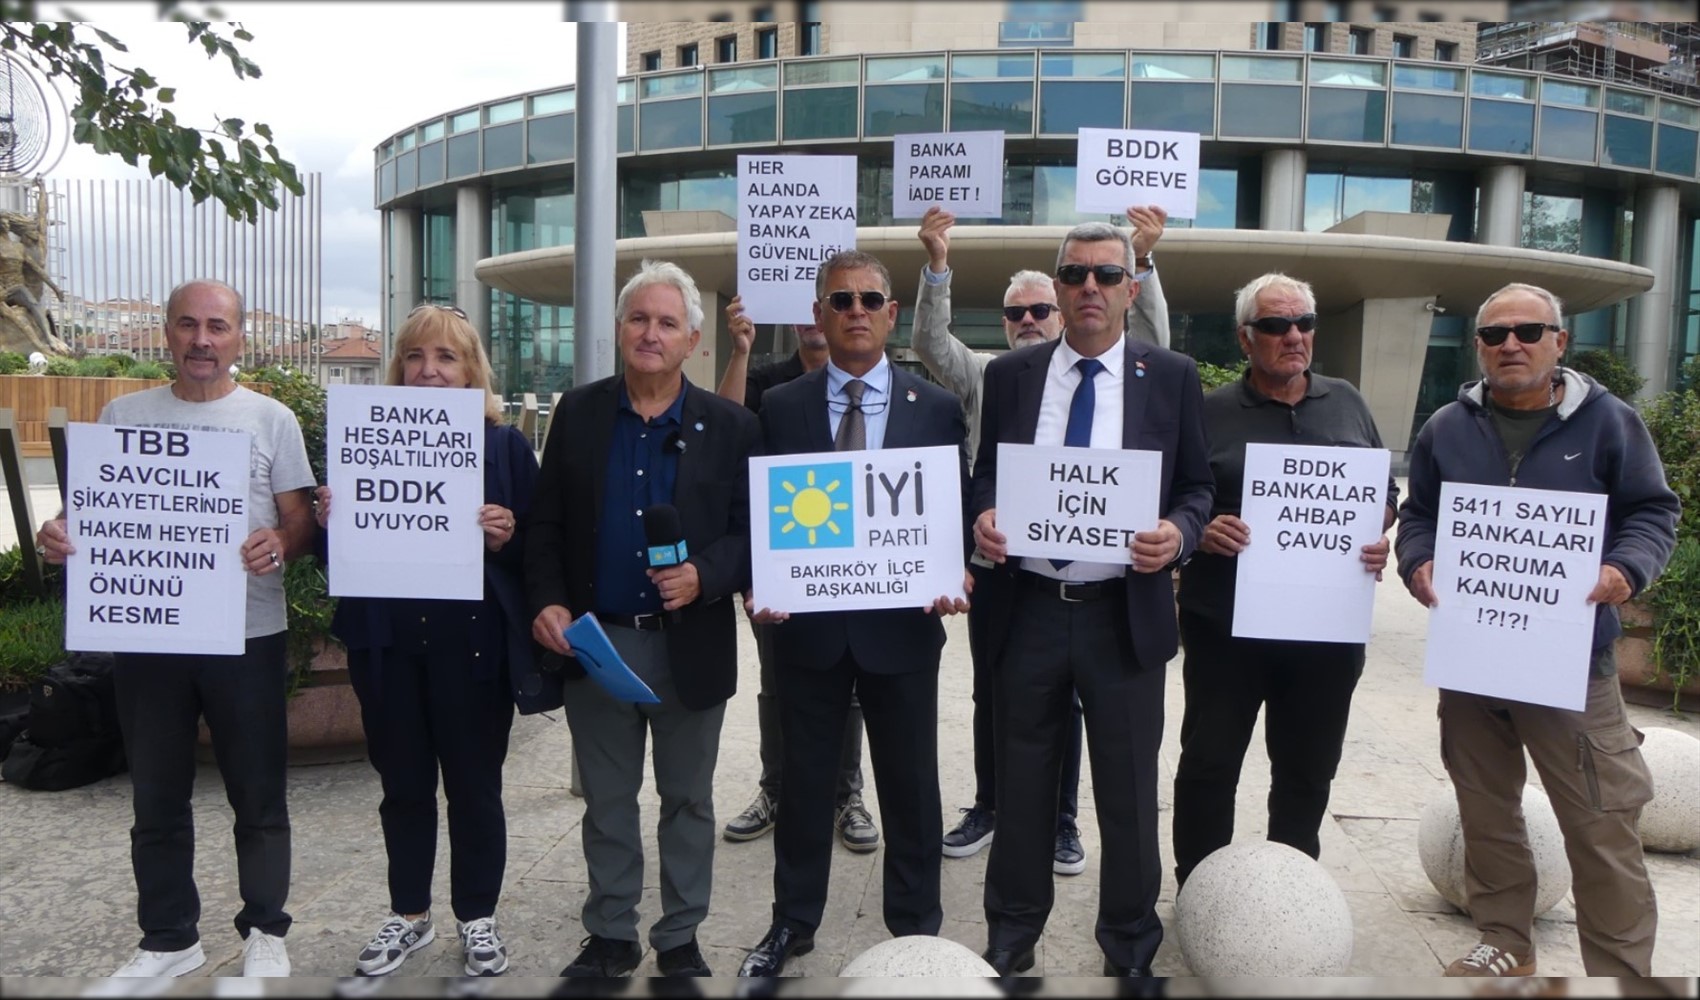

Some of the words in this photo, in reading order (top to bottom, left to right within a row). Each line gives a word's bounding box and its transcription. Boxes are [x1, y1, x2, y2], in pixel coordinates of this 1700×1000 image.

[910, 142, 967, 158] BANKA
[1107, 138, 1179, 161] BDDK
[748, 160, 784, 175] HER
[909, 164, 971, 180] PARAMI
[1095, 165, 1187, 190] GÖREVE
[747, 182, 820, 197] ALANDA
[908, 186, 945, 202] İADE
[949, 186, 971, 201] ET
[975, 186, 980, 202] !
[747, 204, 806, 219] YAPAY
[808, 205, 856, 221] ZEKA
[749, 223, 811, 240] BANKA
[747, 264, 789, 282] GERİ
[794, 266, 816, 281] ZE
[370, 405, 451, 427] BANKA
[114, 428, 190, 458] TBB
[345, 427, 472, 448] HESAPLARI
[341, 447, 478, 470] BOŞALTILIYOR
[1282, 457, 1347, 479] BDDK
[98, 463, 221, 489] SAVCILIK
[1049, 462, 1120, 486] HALK
[72, 487, 244, 515] ŞİKAYETLERİNDE
[355, 478, 447, 505] BDDK
[865, 460, 925, 518] İYİ
[1251, 479, 1377, 504] BANKALAR
[1057, 492, 1107, 519] İÇİN
[1277, 505, 1357, 527] AHBAP
[1452, 496, 1502, 517] 5411
[1514, 502, 1596, 527] SAYILI
[79, 519, 152, 540] HAKEM
[159, 523, 229, 544] HEYETİ
[354, 511, 450, 532] UYUYOR
[868, 524, 928, 548] PARTİ
[1027, 523, 1135, 549] SİYASET
[1276, 530, 1353, 556] ÇAVUŞ
[1453, 521, 1595, 553] BANKALARI
[90, 547, 215, 571] HAKKININ
[790, 562, 878, 579] BAKIRKÖY
[887, 559, 926, 578] İLÇE
[1458, 550, 1567, 579] KORUMA
[89, 572, 183, 598] ÖNÜNÜ
[805, 580, 908, 599] BAŞKANLIĞI
[1457, 576, 1560, 605] KANUNU
[89, 604, 180, 626] KESME
[1477, 607, 1529, 631] !?!?!
